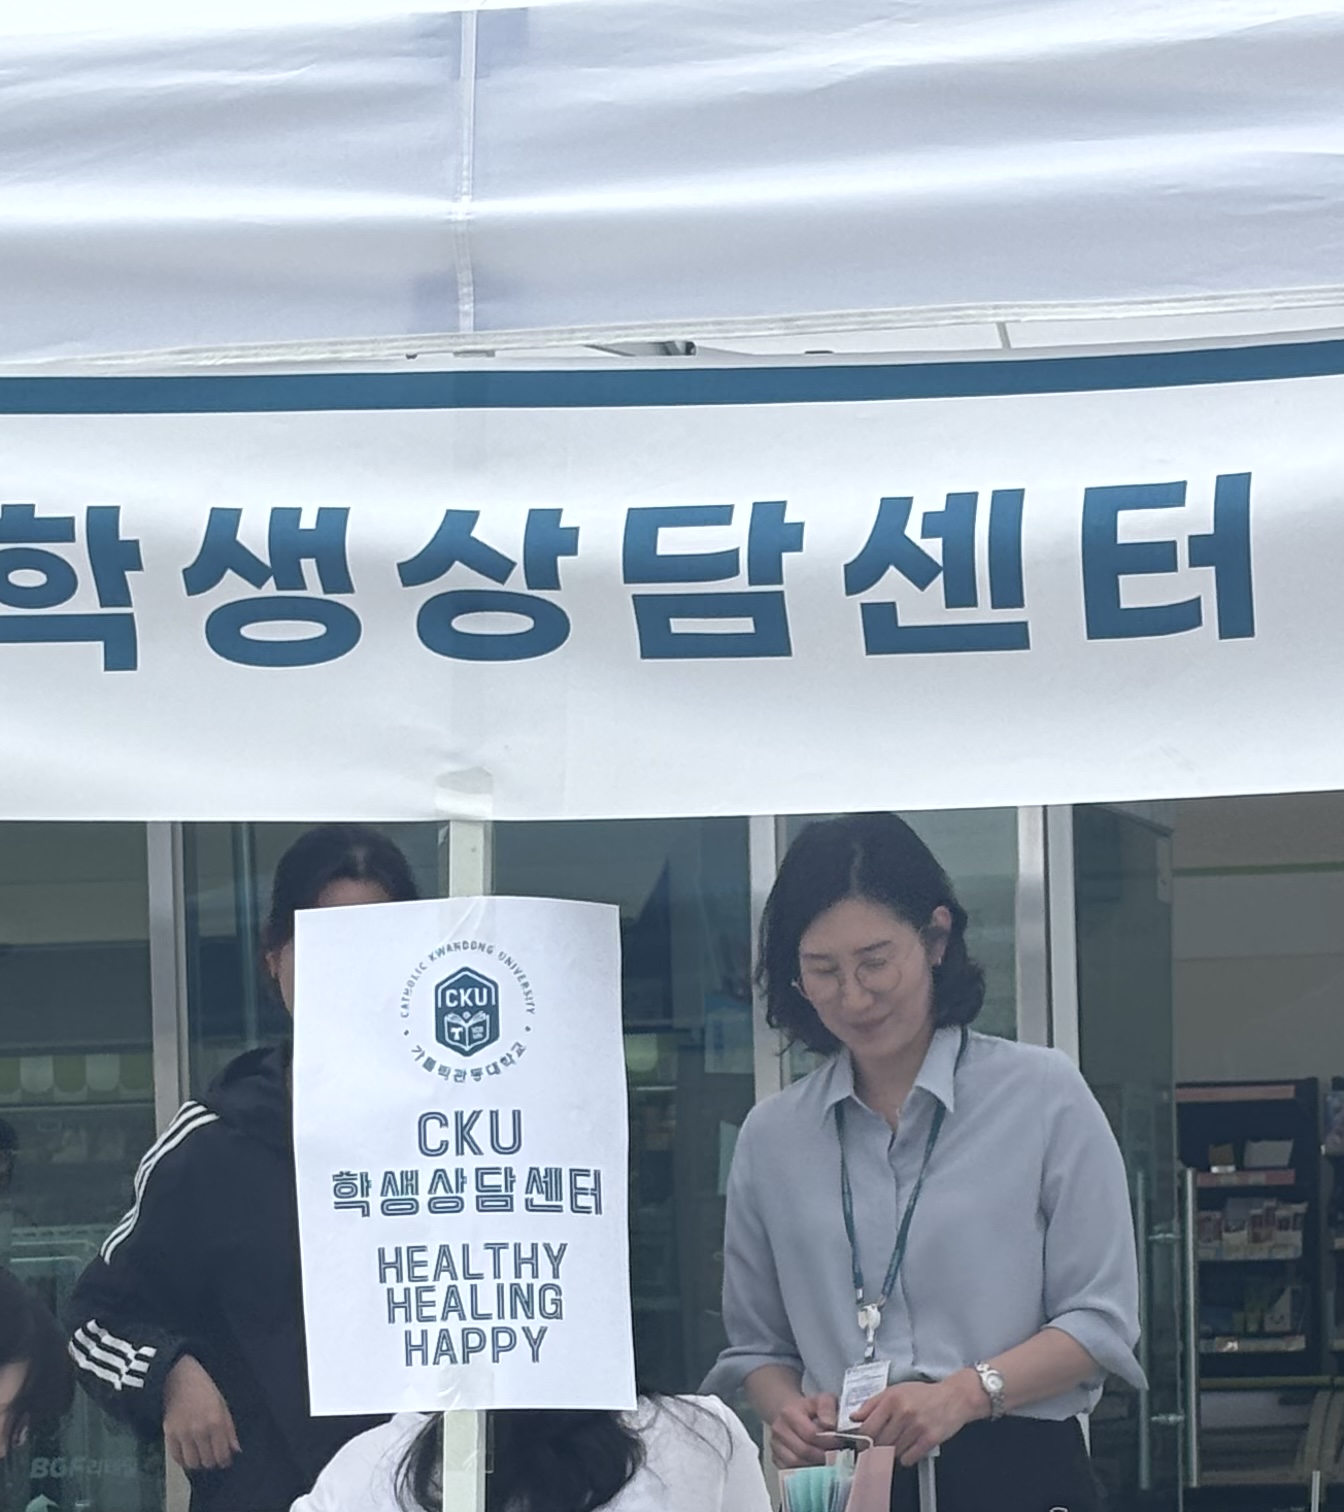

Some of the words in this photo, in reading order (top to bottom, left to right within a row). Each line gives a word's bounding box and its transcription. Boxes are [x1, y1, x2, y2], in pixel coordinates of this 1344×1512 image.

[445, 988, 487, 1007] CKU
[417, 1109, 523, 1157] CKU
[332, 1166, 603, 1218] 학생상담센터
[377, 1242, 568, 1284] HEALTHY
[387, 1283, 564, 1325] HEALING
[404, 1326, 548, 1367] HAPPY
